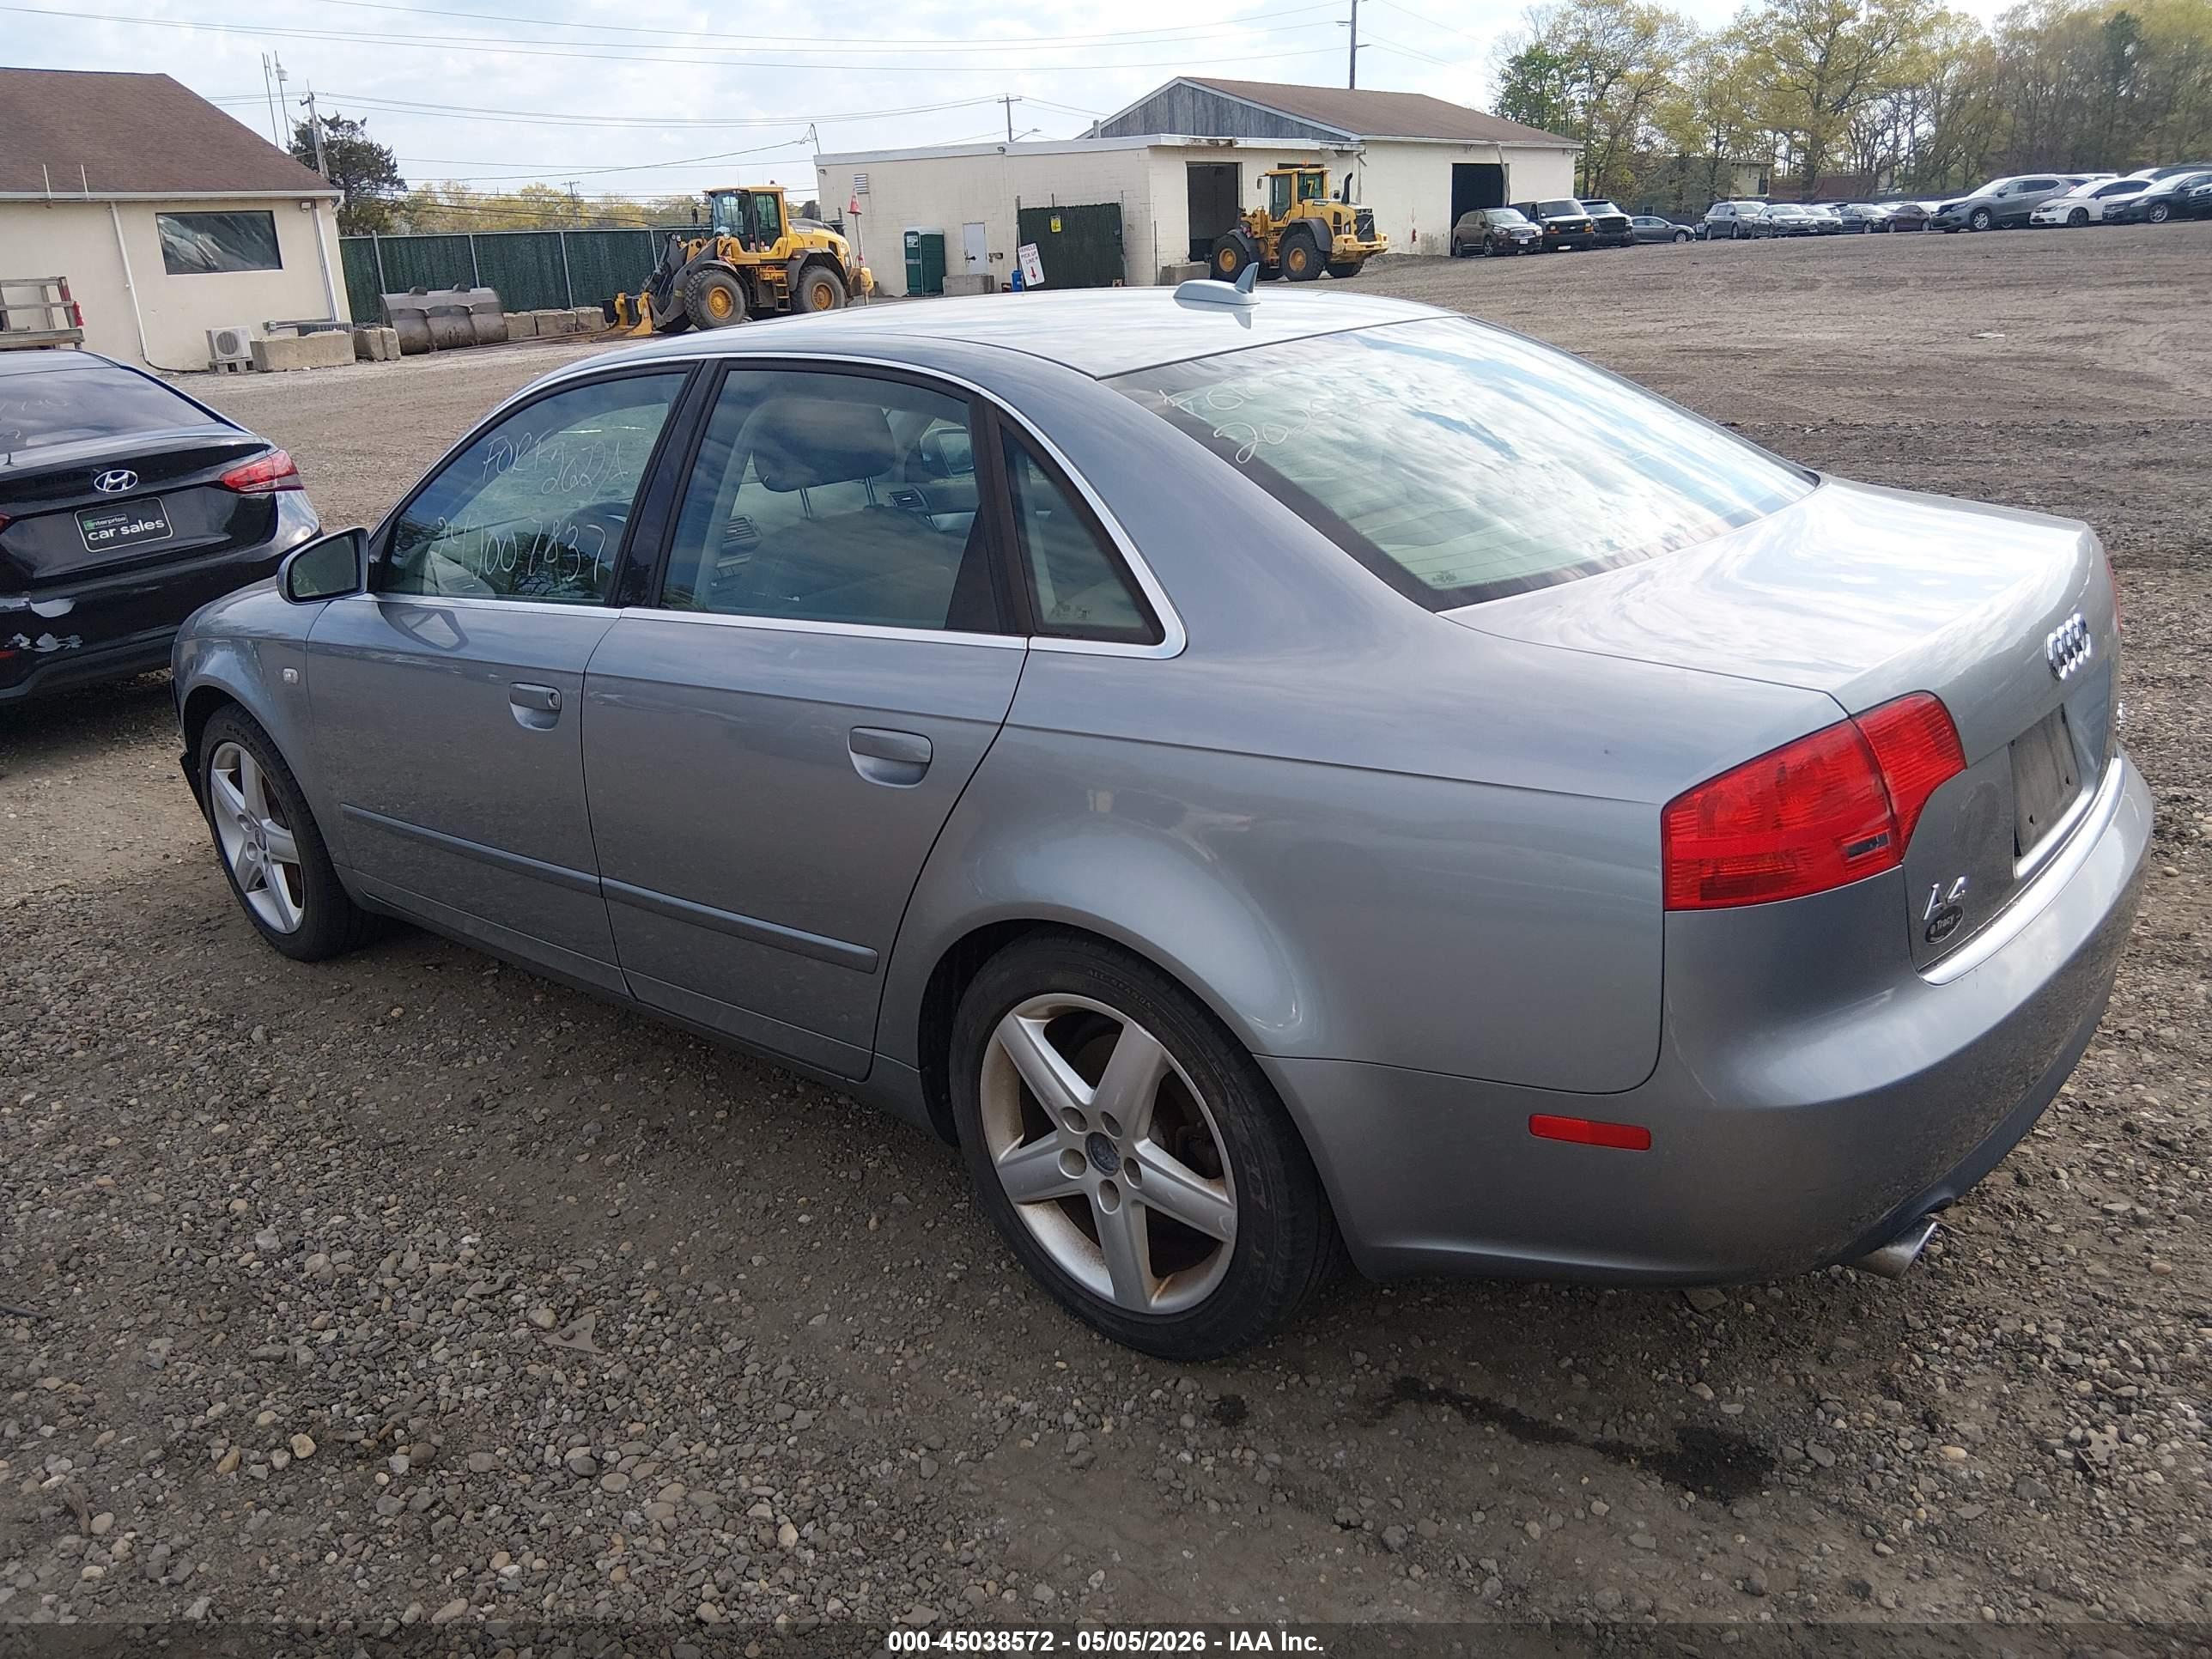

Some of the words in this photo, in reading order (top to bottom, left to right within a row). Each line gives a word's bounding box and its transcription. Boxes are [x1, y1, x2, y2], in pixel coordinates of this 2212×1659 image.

[1307, 179, 1315, 197] 7
[86, 517, 126, 527] enterprise
[88, 528, 116, 540] car
[120, 520, 165, 534] sales
[1922, 876, 1966, 921] A4
